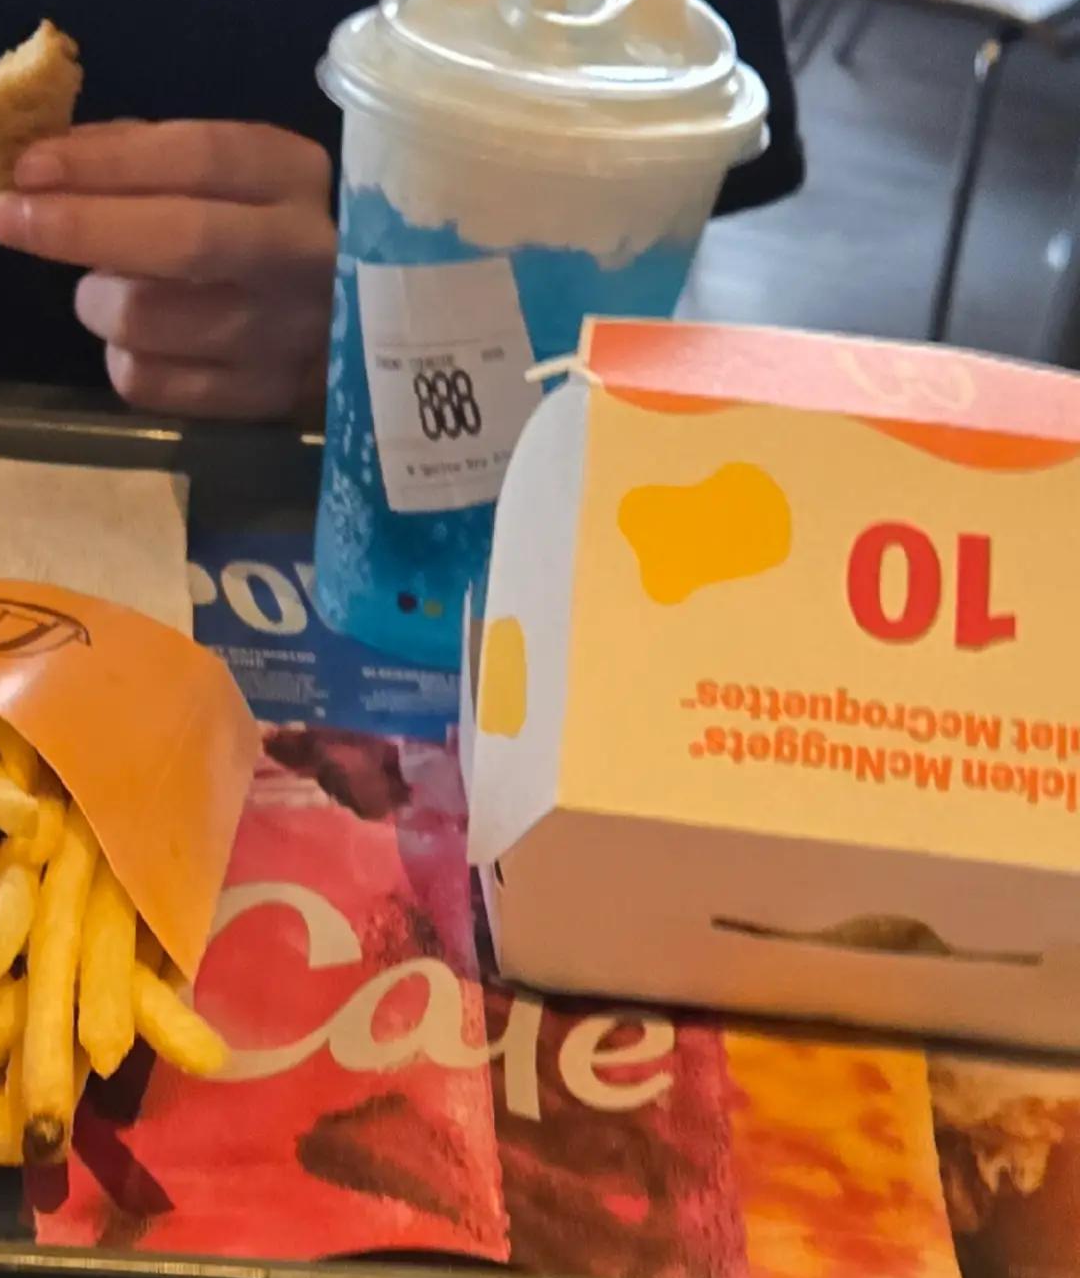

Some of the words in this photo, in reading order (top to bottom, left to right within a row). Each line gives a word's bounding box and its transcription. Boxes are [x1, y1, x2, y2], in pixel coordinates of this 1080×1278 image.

[413, 369, 482, 442] 888
[846, 520, 1017, 652] 10
[1011, 719, 1080, 762] let
[961, 757, 1080, 814] icken
